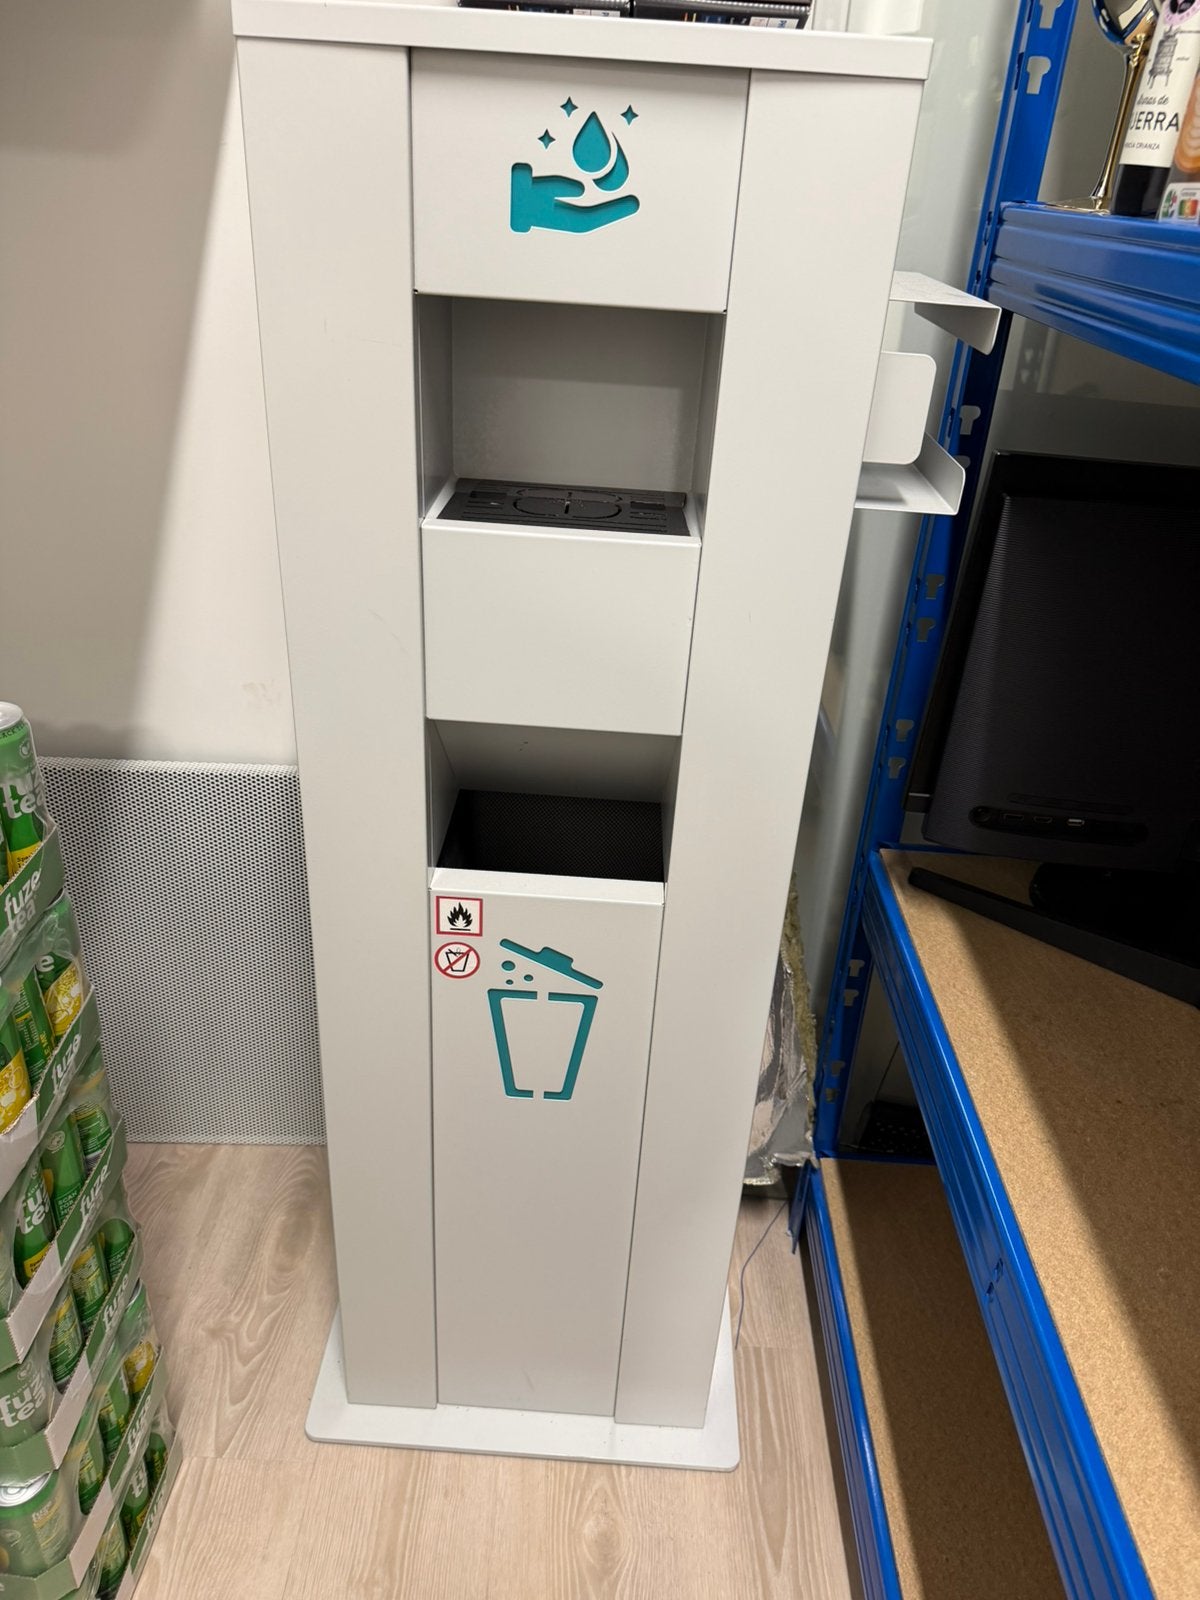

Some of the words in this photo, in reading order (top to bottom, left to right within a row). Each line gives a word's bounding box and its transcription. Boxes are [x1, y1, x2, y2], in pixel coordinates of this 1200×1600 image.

[5, 868, 41, 920] fuze
[52, 1034, 81, 1090] fuze
[80, 1164, 109, 1219] fuze
[0, 1387, 46, 1427] tea
